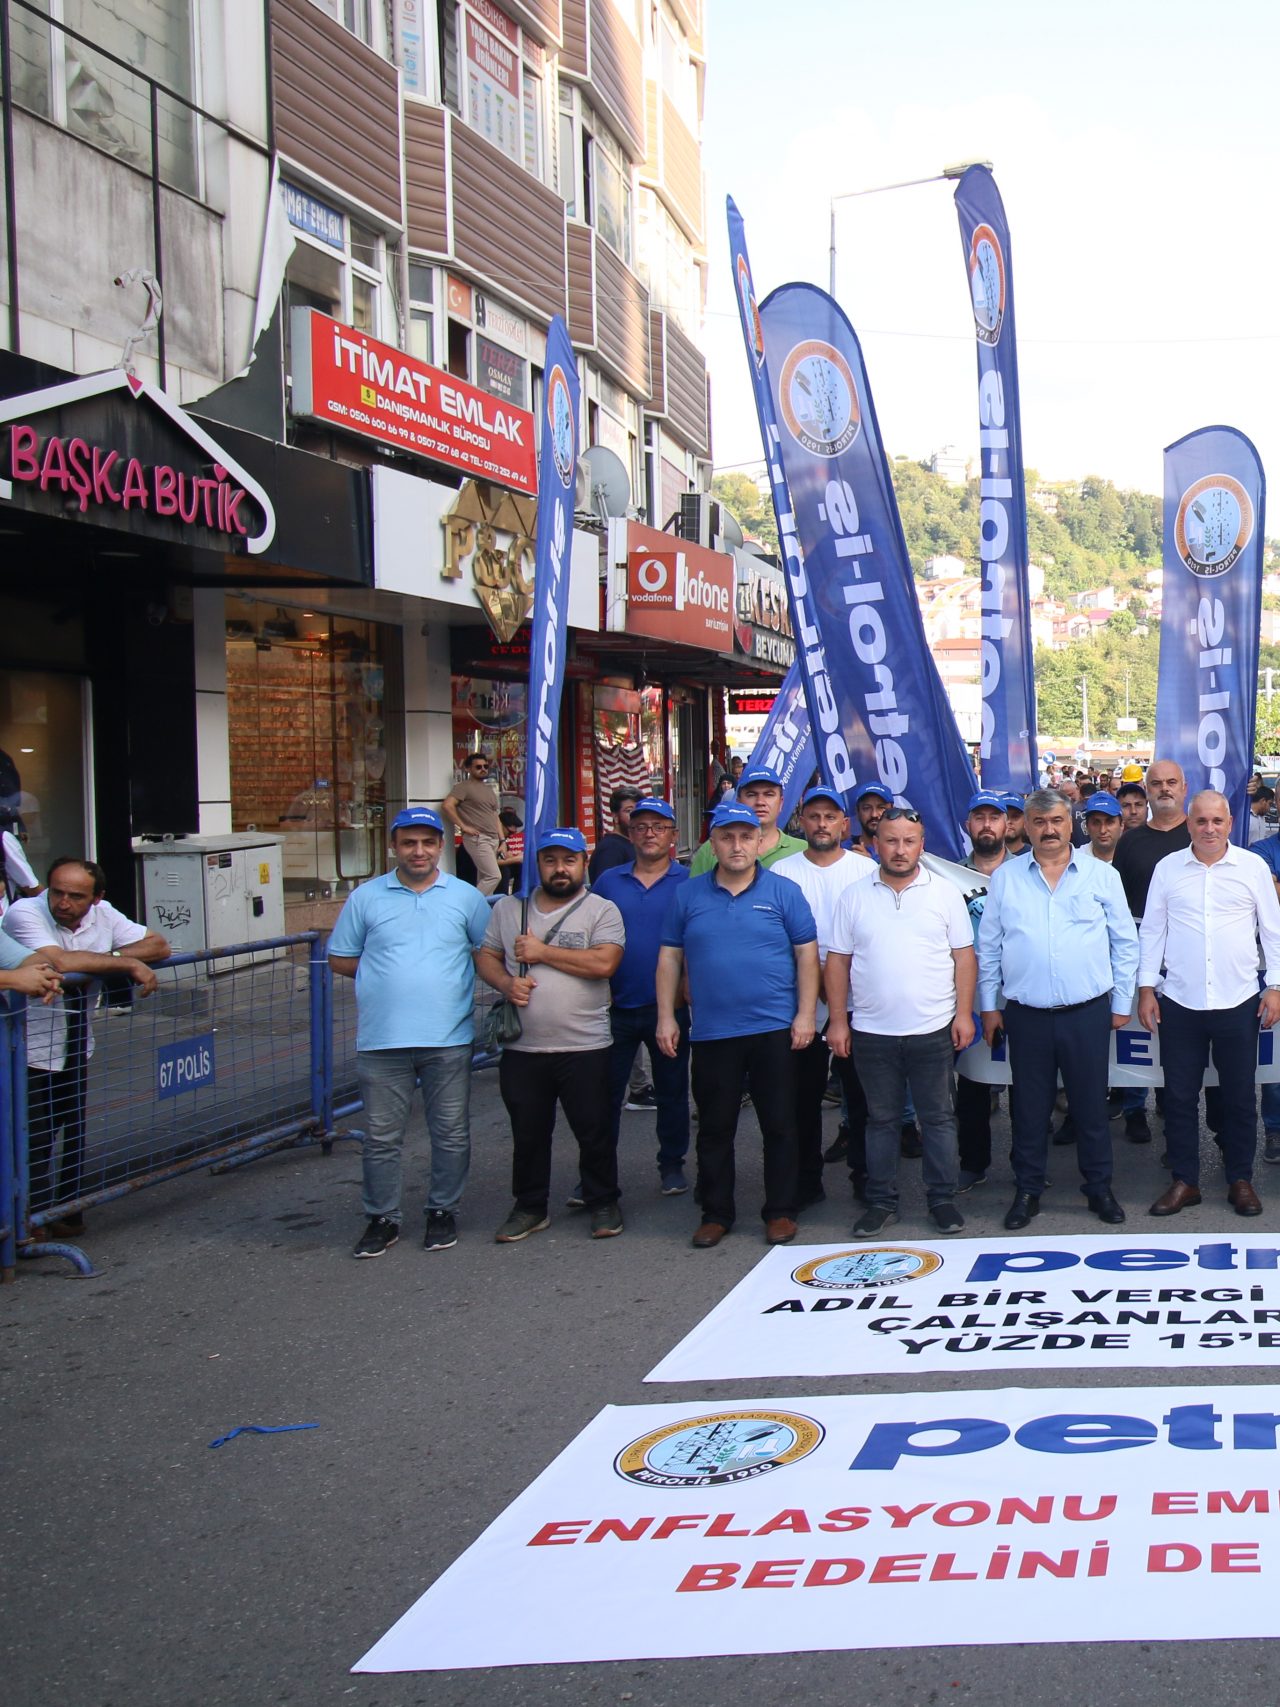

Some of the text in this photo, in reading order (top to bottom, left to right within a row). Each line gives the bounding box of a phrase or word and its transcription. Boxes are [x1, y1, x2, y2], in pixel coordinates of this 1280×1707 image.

[310, 202, 341, 241] EMLAK
[333, 325, 432, 404] İTİMAT
[439, 383, 524, 447] EMLAK
[488, 365, 513, 386] OSMAN
[327, 399, 349, 417] GSM:
[350, 407, 371, 425] 0506
[371, 417, 387, 431] 600
[388, 423, 398, 436] 66
[398, 427, 409, 440] 99
[410, 431, 416, 443] &
[417, 434, 436, 449] 0507
[437, 441, 450, 455] 227
[450, 446, 460, 458] 68
[377, 393, 491, 452] DANIŞMANLIK BÜROSU
[11, 424, 248, 535] BAŞKA BUTİK
[632, 592, 673, 603] vodafone
[160, 1045, 211, 1088] 67 POLİS
[762, 1293, 913, 1315] ADİL
[937, 1286, 1047, 1308] BİR
[1071, 1285, 1264, 1303] VERGİ
[899, 1332, 1131, 1355] YÜZDE
[726, 1463, 773, 1482] 1950
[528, 1496, 1117, 1546] ENFLASYONU
[677, 1543, 1109, 1593] BEDELİNİ
[1147, 1543, 1261, 1573] DE
